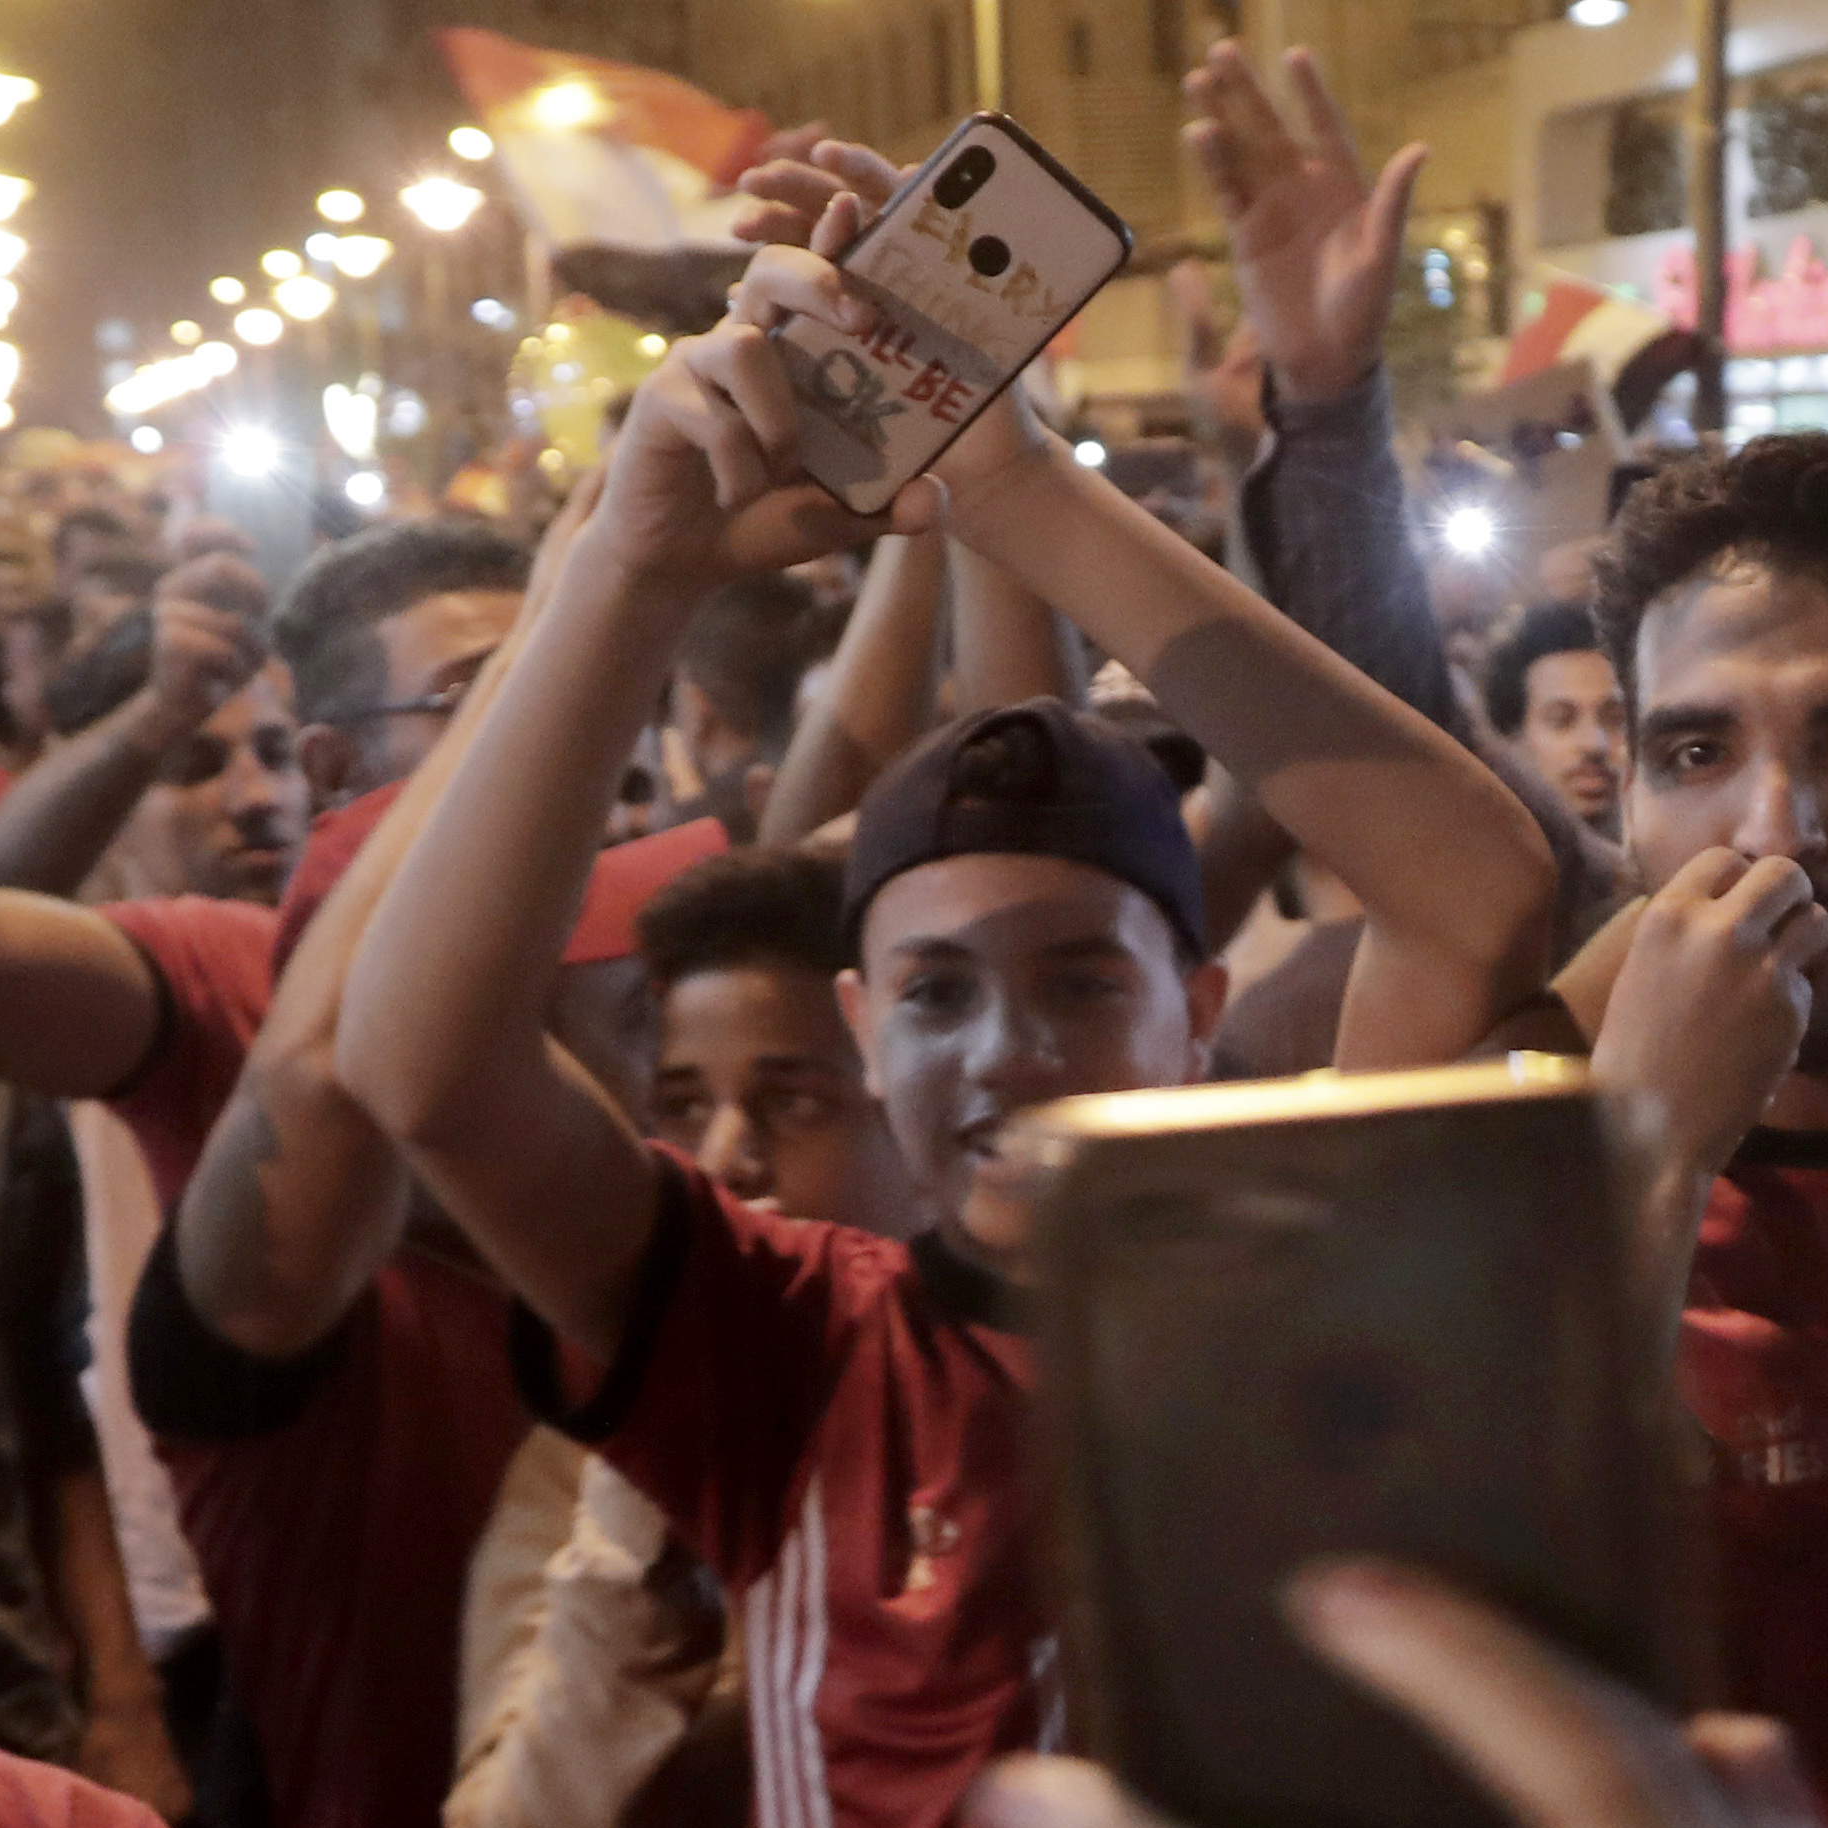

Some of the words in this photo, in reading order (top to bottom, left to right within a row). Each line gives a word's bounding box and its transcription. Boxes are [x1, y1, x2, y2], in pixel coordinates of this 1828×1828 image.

[909, 196, 1070, 318] EVRY
[815, 349, 910, 443] OK
[902, 360, 976, 426] BE
